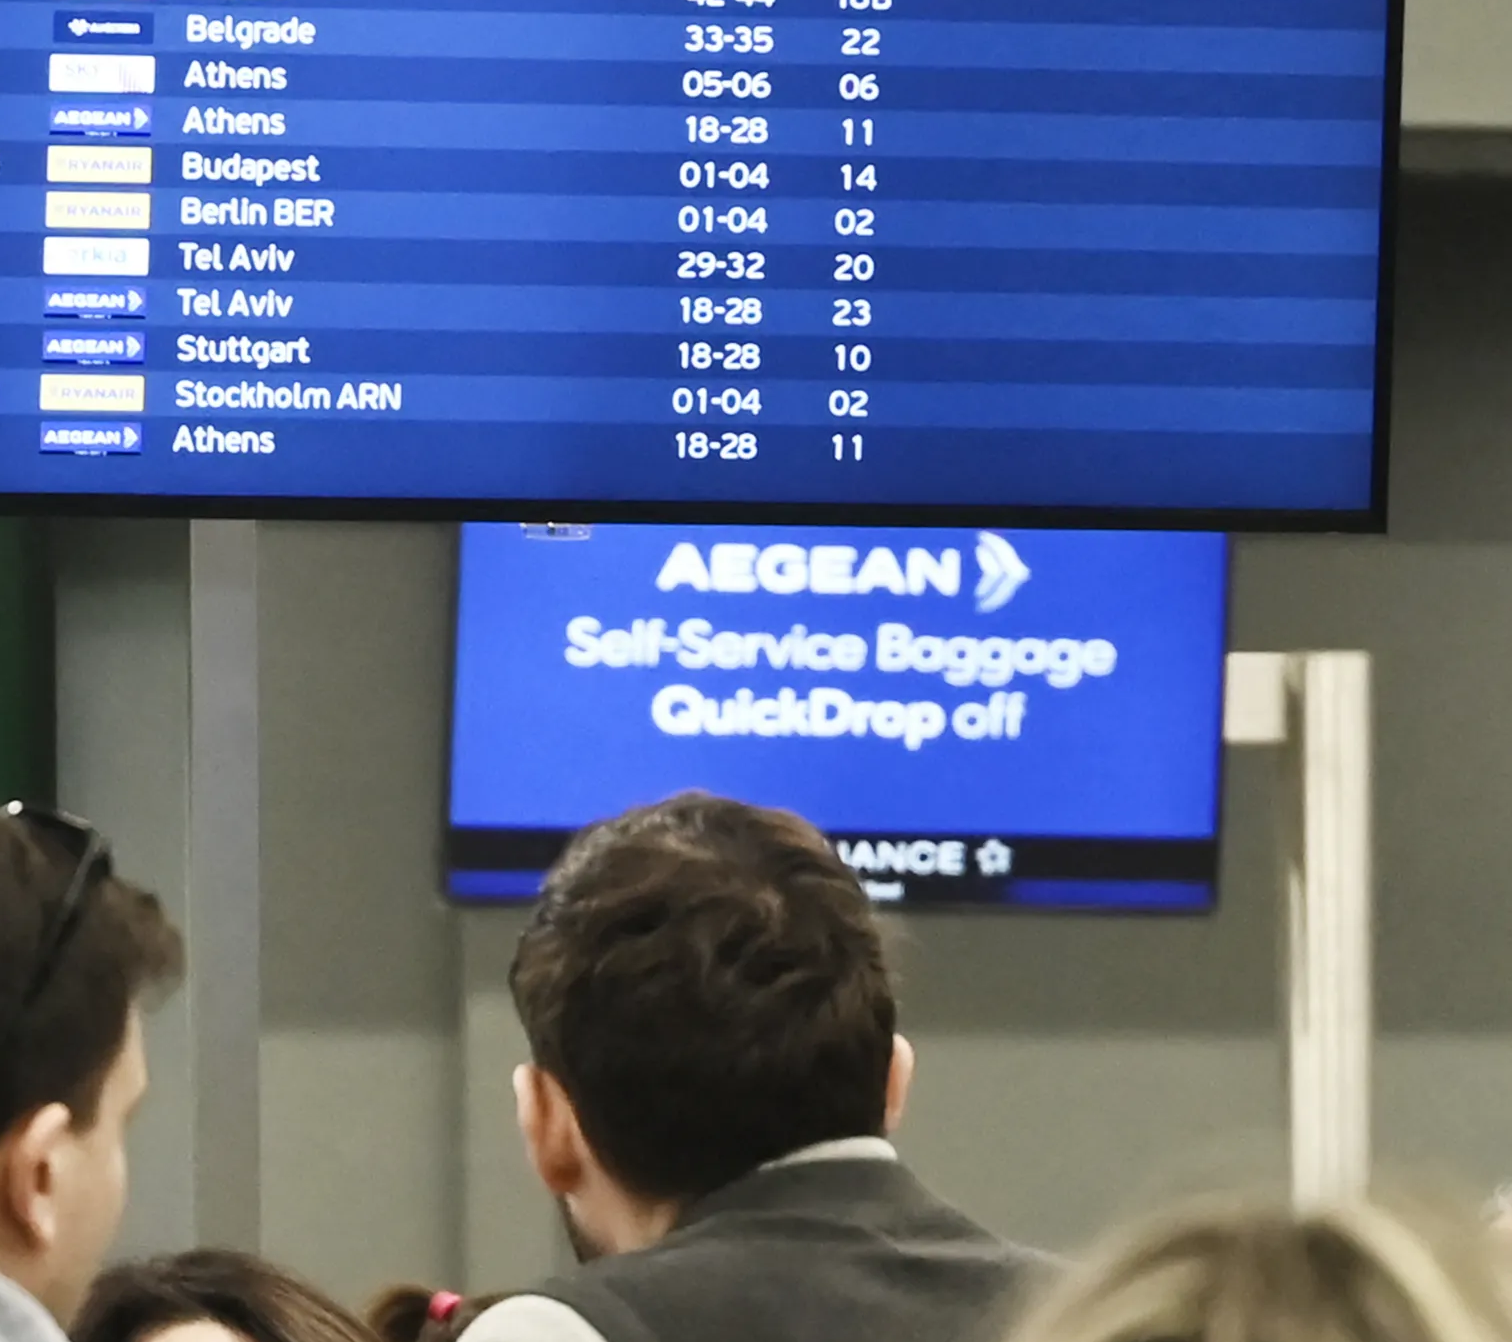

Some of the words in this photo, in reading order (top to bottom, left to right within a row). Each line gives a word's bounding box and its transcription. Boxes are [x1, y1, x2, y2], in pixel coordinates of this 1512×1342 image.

[181, 151, 321, 187] Budapest
[679, 161, 770, 189] 01-04
[840, 163, 878, 191] 14
[178, 242, 224, 271] Tel
[228, 243, 295, 272] Aviv
[677, 251, 765, 280] 29-32
[833, 253, 875, 281] 20
[47, 338, 124, 356] AEGEAN
[176, 334, 311, 370] Stuttgart
[678, 341, 761, 370] 18-28
[834, 344, 871, 372] 10
[656, 542, 961, 596] AEGEAN
[565, 616, 868, 671] Self-Service
[876, 622, 1117, 689] Baggage
[651, 684, 946, 749] QuickDrop
[952, 691, 1026, 740] off
